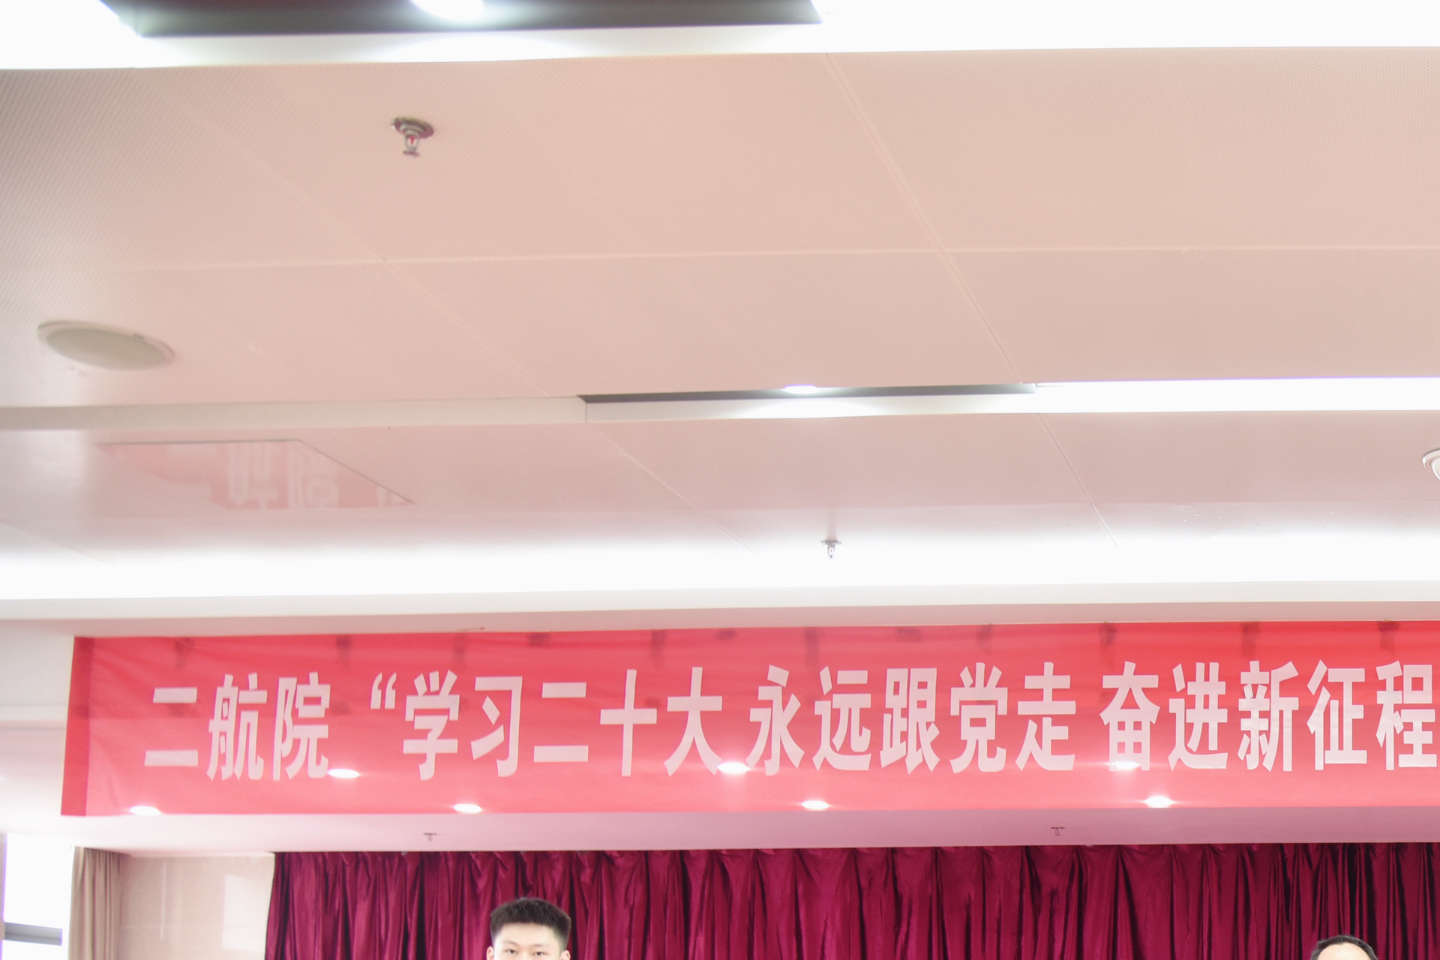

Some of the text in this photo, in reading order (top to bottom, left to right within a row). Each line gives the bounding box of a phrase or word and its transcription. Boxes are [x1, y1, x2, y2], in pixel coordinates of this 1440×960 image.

[145, 672, 330, 779] 二航院
[371, 667, 724, 779] “学习二十大
[748, 663, 1076, 775] 永远跟党走
